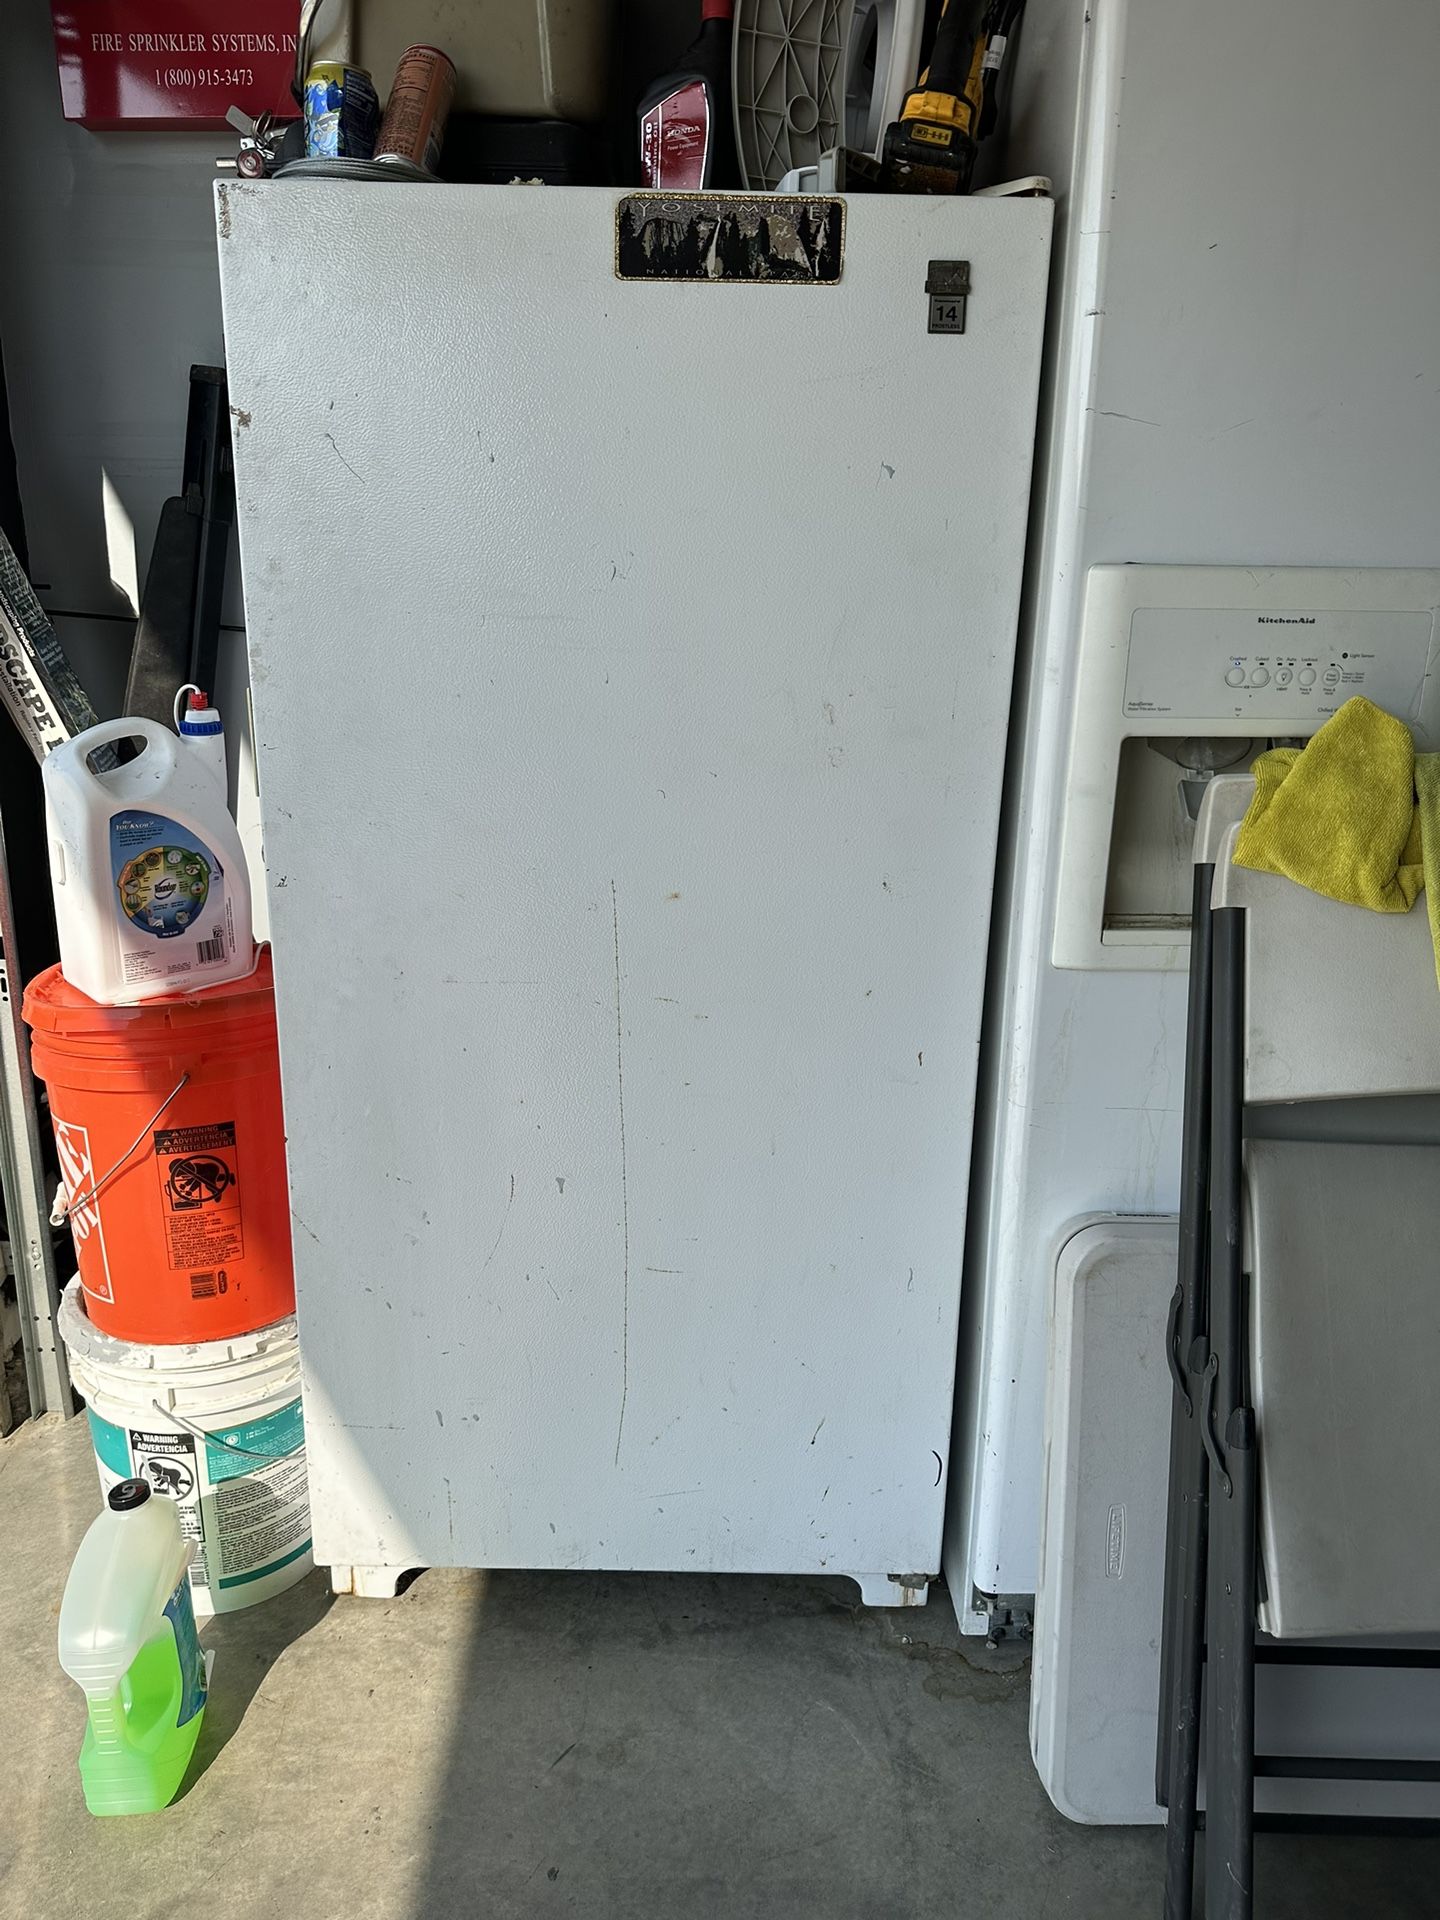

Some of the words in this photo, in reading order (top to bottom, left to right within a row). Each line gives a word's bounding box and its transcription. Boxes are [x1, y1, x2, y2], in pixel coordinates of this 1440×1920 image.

[91, 33, 123, 52] FIRE
[129, 33, 206, 52] SPRINKLER
[212, 33, 280, 55] SYSTEMS,
[283, 34, 299, 52] IN
[155, 69, 161, 86] 1
[164, 69, 196, 88] (800)
[199, 69, 254, 86] 915-3473
[667, 125, 701, 138] HONDA
[638, 202, 823, 222] YOSEMITE
[936, 305, 958, 321] 14
[16, 626, 36, 658] Products
[179, 1125, 218, 1136] WARNING
[173, 1132, 228, 1145] ADVERTENCIA
[142, 1433, 178, 1444] WARNING
[137, 1442, 188, 1453] ADVERTENCIA
